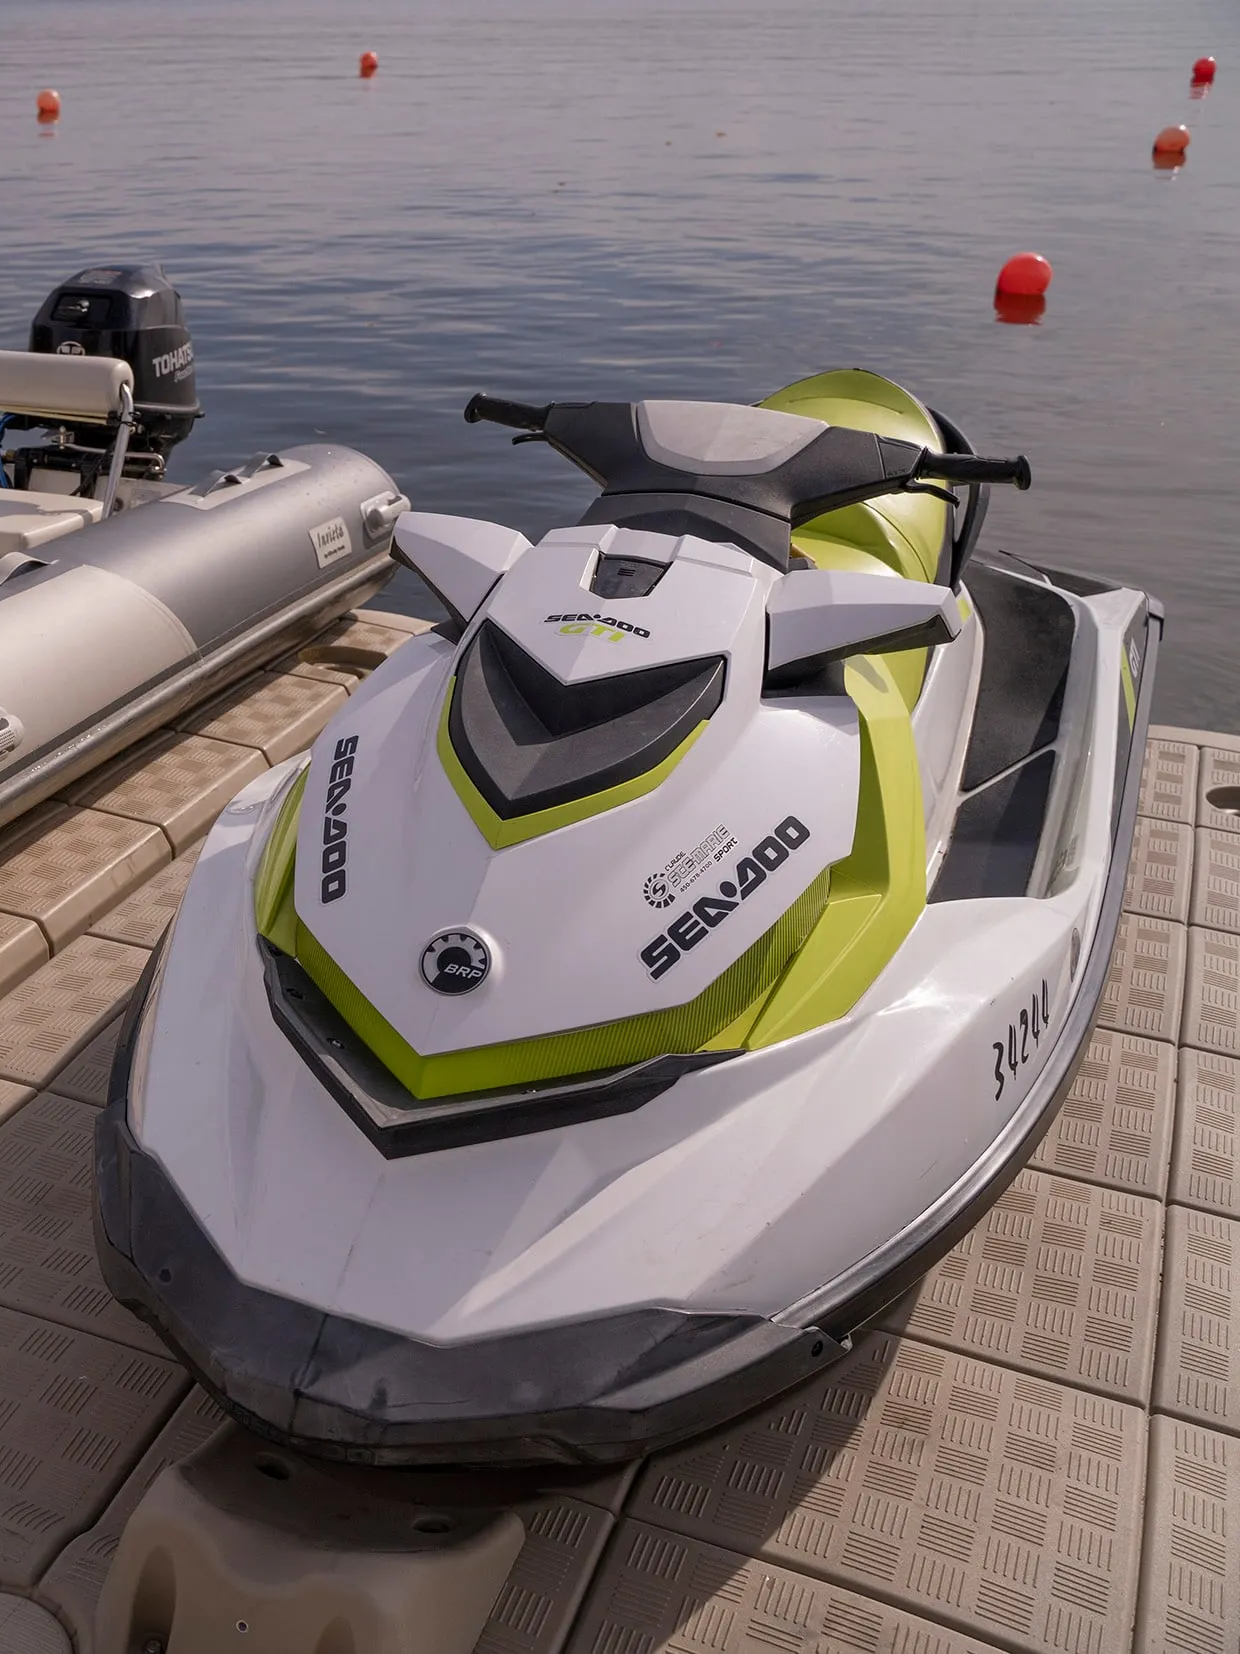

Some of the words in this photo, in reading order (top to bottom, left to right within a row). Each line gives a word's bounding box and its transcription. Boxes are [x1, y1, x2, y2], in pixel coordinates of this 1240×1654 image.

[152, 341, 193, 377] TOHATS
[560, 623, 626, 643] GTI
[713, 837, 738, 862] SPORT
[444, 963, 483, 979] BRP
[992, 978, 1050, 1101] 34244
